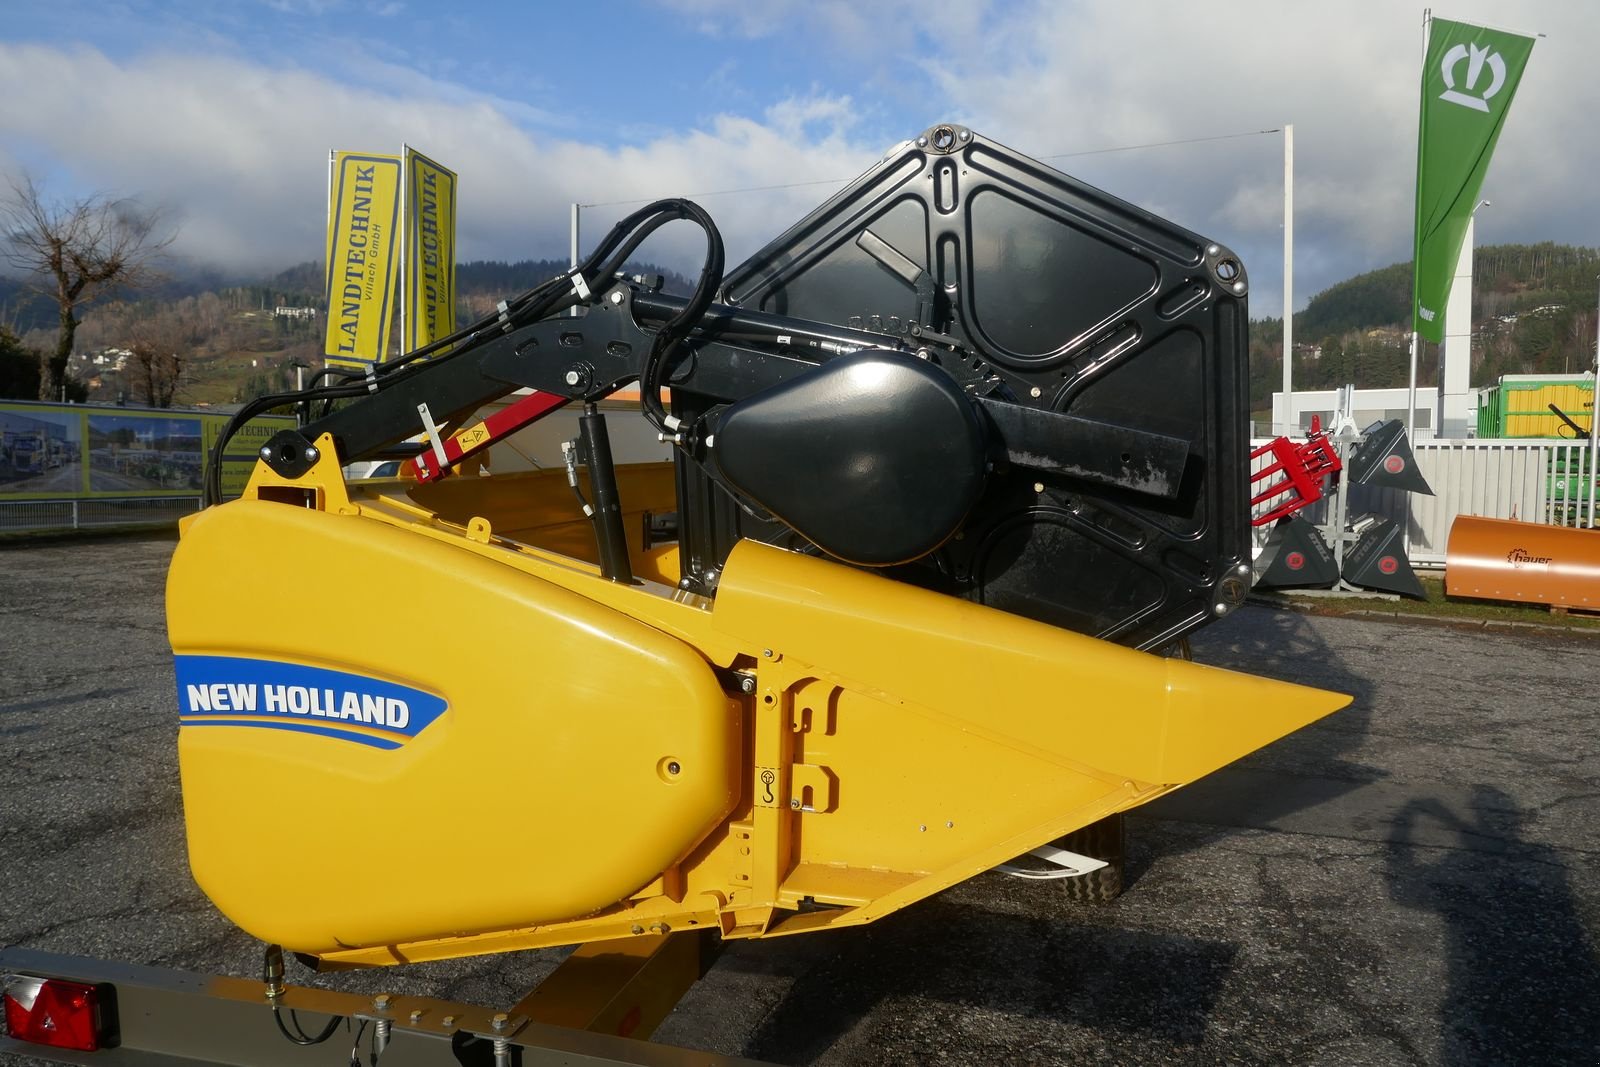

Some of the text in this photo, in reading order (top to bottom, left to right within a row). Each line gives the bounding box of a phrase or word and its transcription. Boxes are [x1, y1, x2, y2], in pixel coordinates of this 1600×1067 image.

[338, 165, 375, 353] LANDTECHNIK
[365, 223, 382, 301] Villach GmbH
[1514, 553, 1553, 564] hauer
[187, 683, 410, 730] NEW HOLLAND
